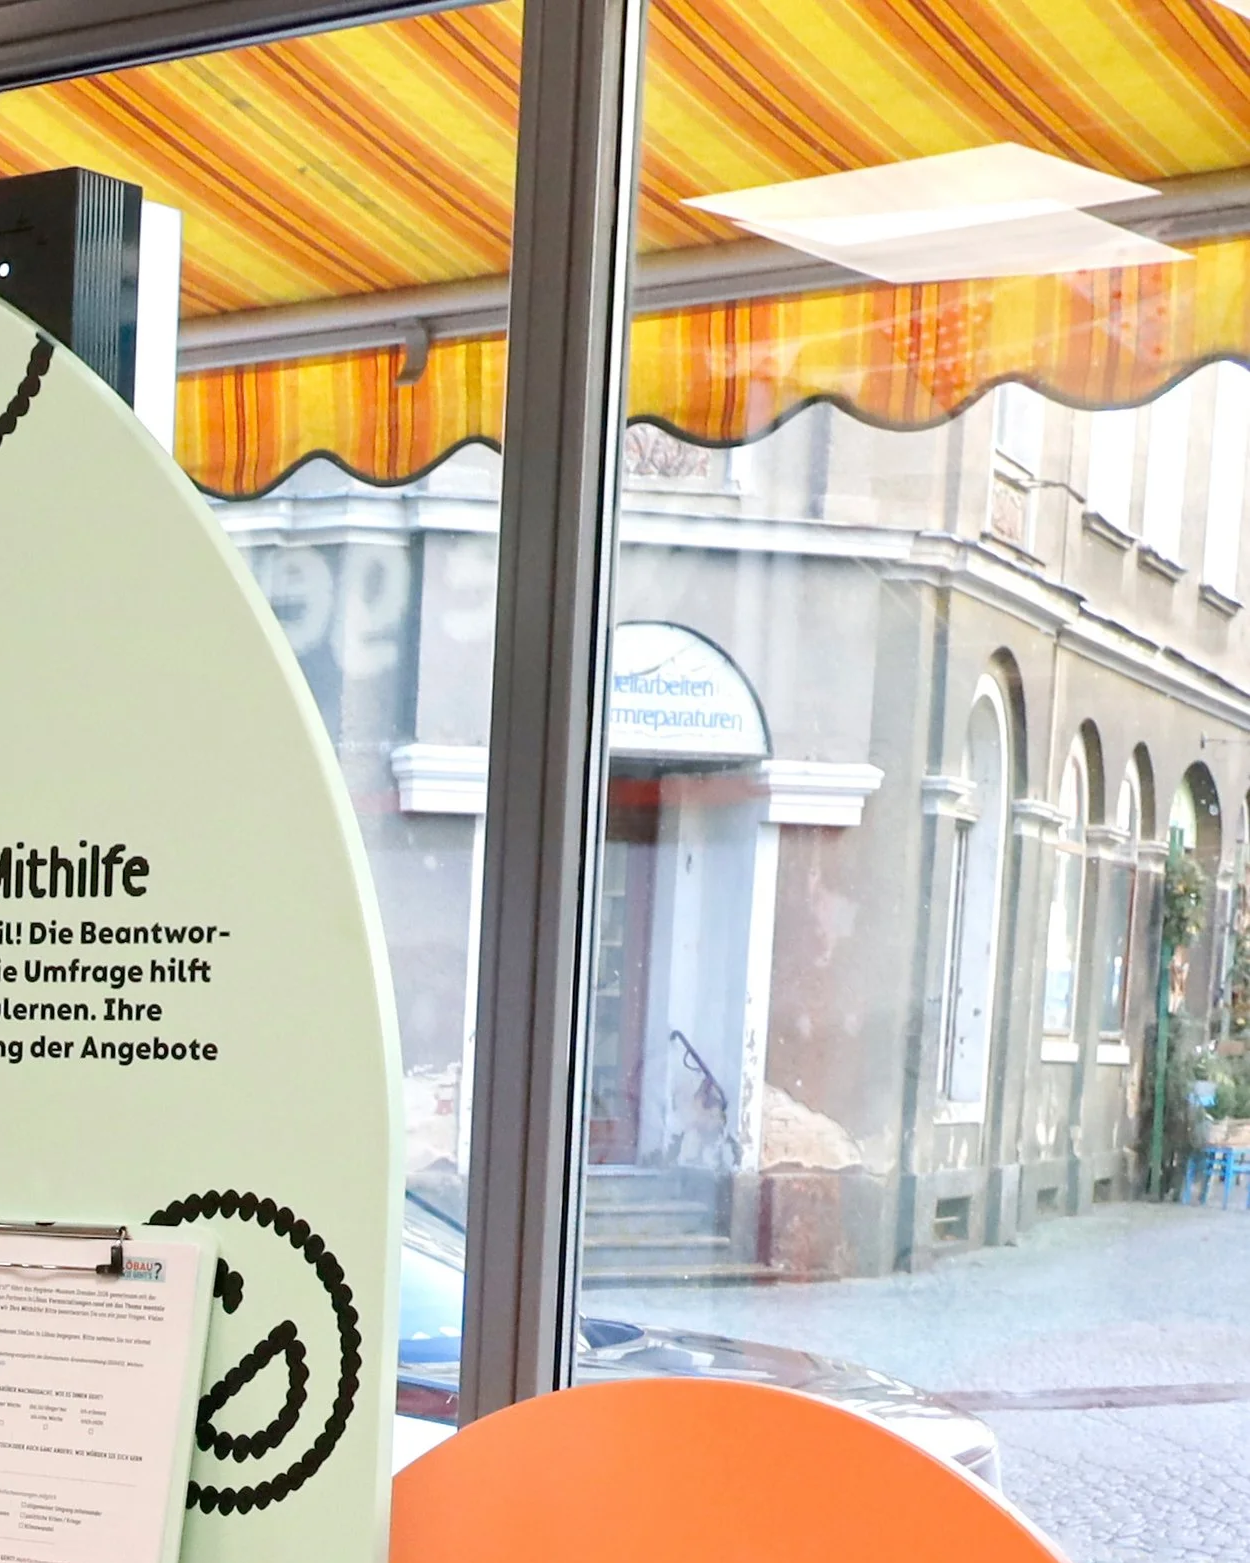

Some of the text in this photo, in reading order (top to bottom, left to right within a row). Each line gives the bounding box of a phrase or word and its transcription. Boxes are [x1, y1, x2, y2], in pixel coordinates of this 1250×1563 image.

[29, 919, 74, 945] Die
[80, 921, 230, 945] Beantwor-
[125, 1260, 153, 1271] ÖBAU
